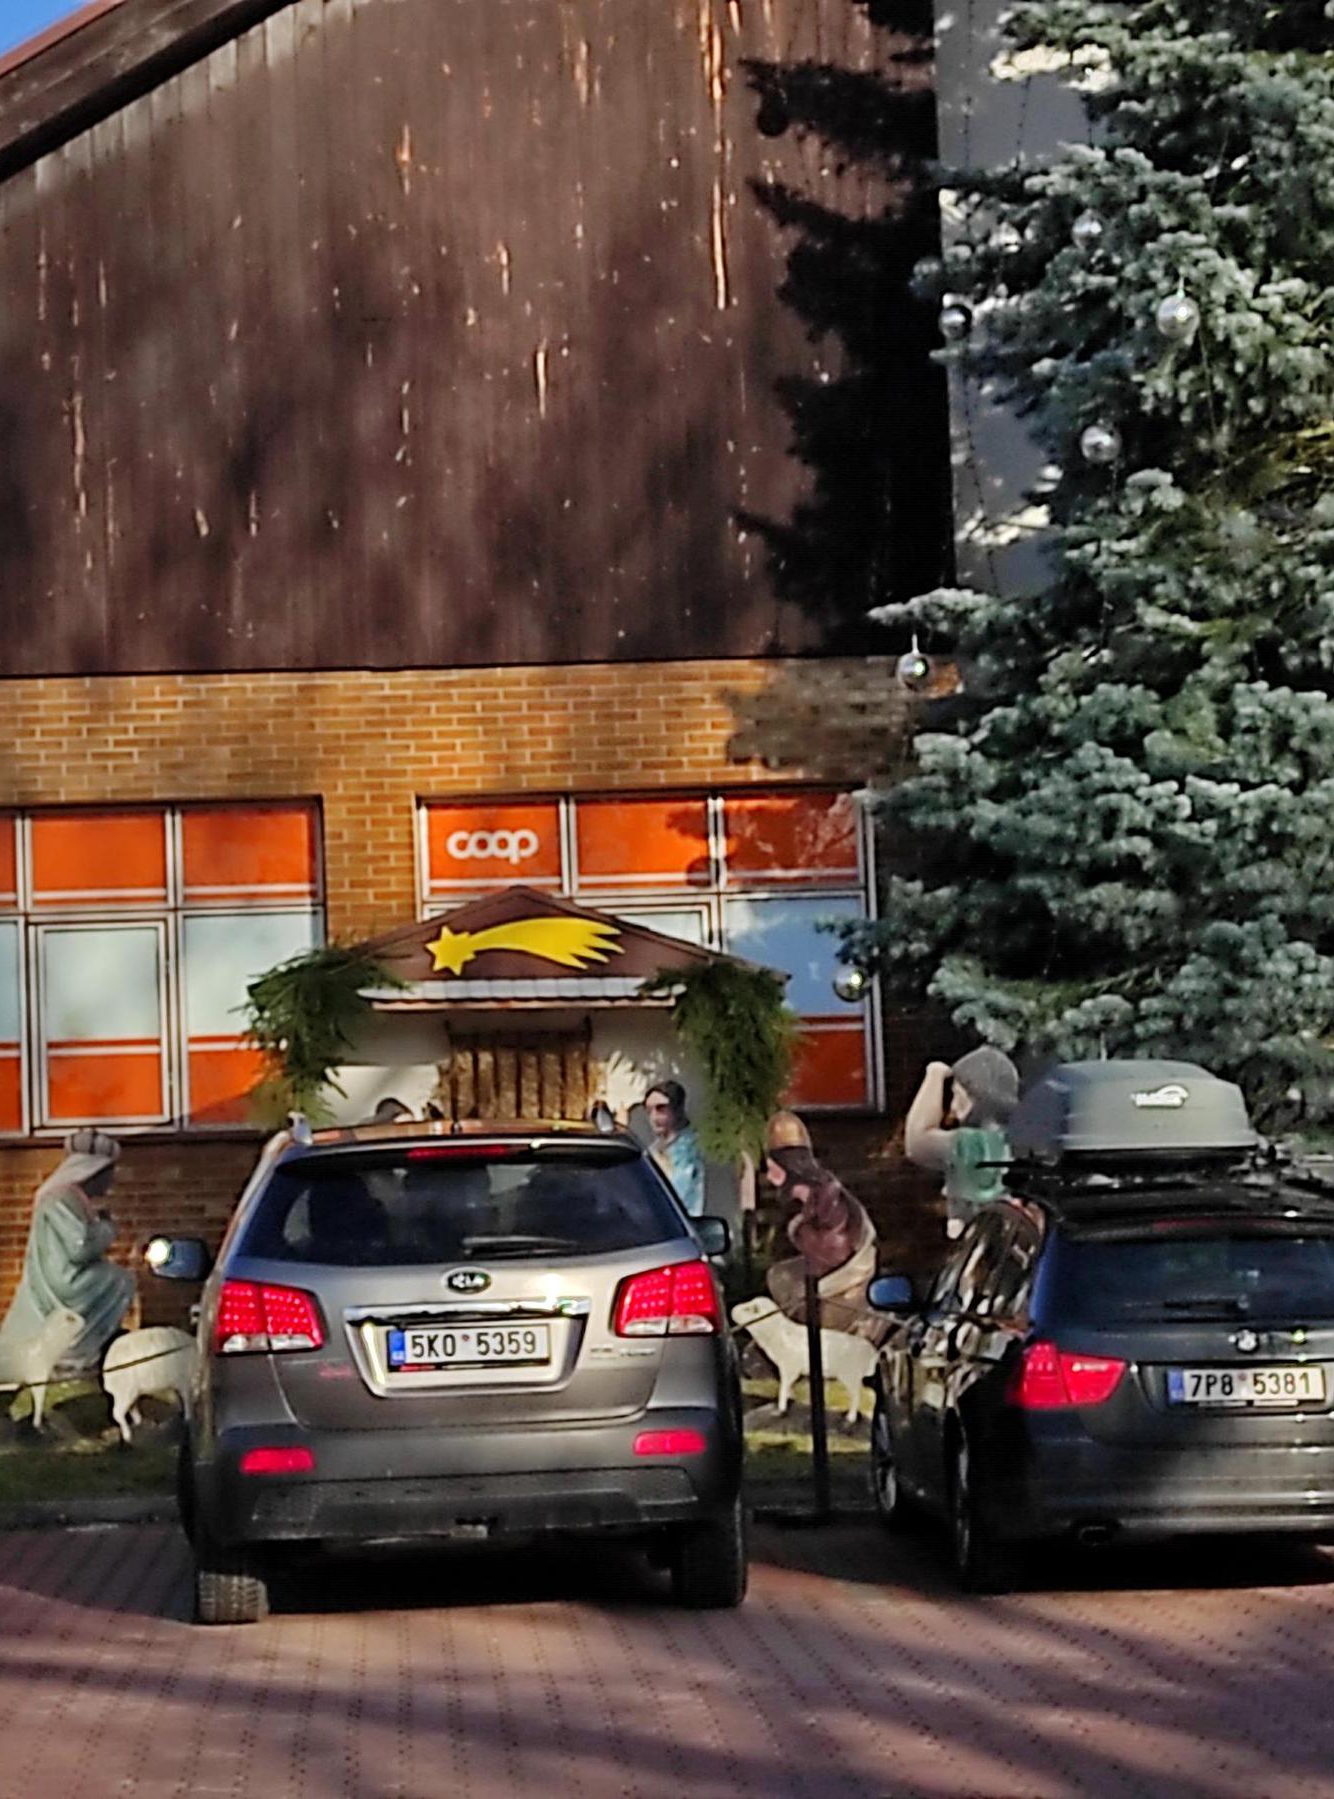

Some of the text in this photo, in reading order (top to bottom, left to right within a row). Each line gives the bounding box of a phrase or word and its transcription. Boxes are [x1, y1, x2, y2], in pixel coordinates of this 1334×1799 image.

[446, 829, 539, 865] coop
[475, 1330, 537, 1357] 5359
[1190, 1373, 1234, 1398] 7P8
[1252, 1371, 1310, 1395] 5381
